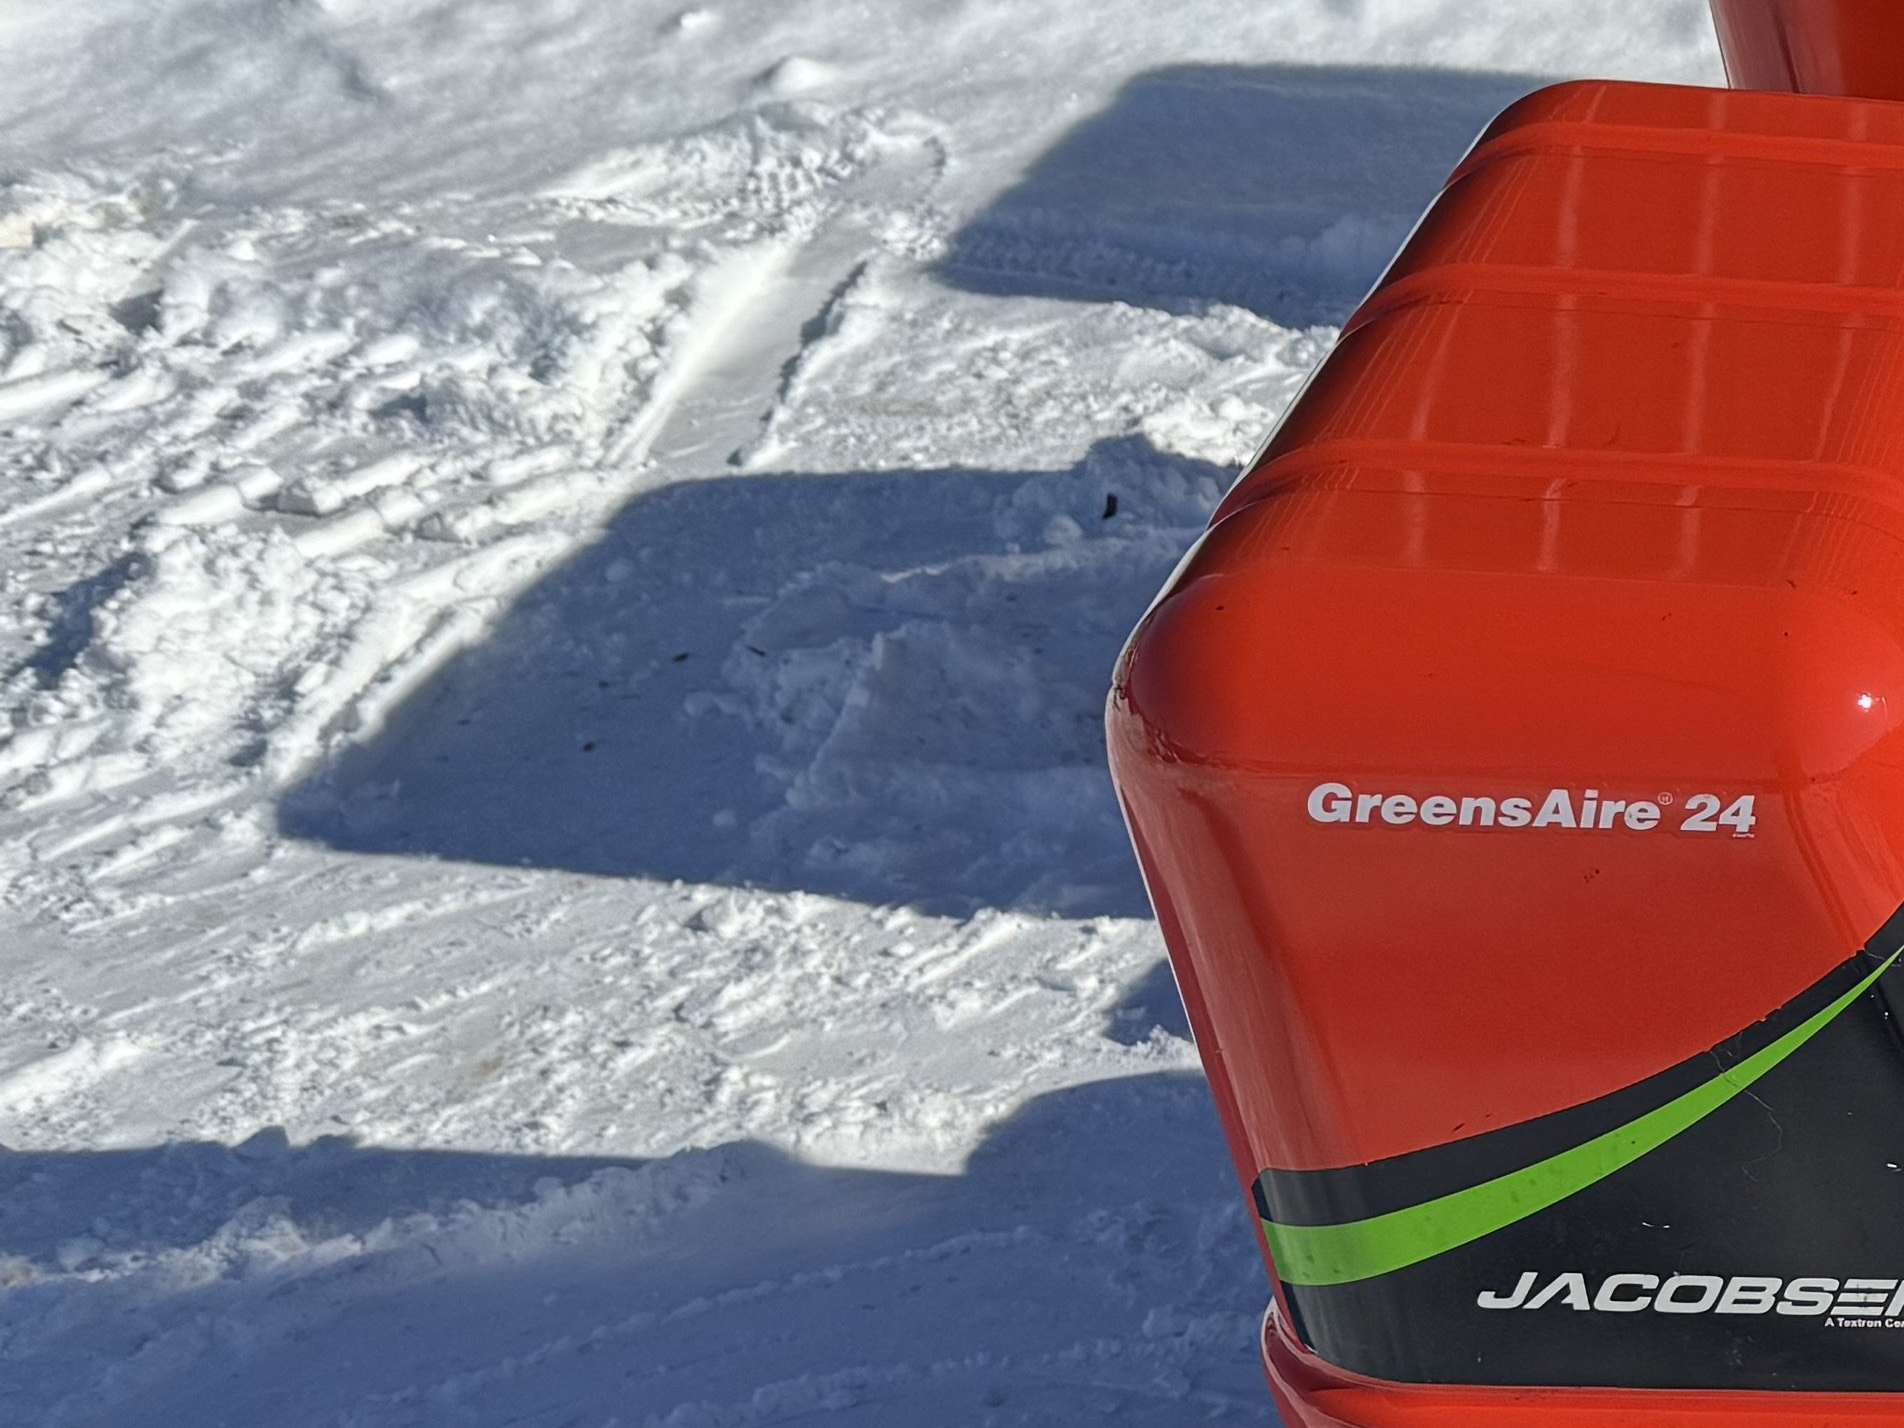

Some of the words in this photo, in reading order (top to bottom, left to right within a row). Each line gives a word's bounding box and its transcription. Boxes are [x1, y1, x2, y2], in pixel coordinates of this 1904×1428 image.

[1306, 782, 1661, 831] GreensAire
[1680, 793, 1757, 833] 24
[1824, 1317, 1835, 1328] A
[1837, 1317, 1882, 1328] Textron
